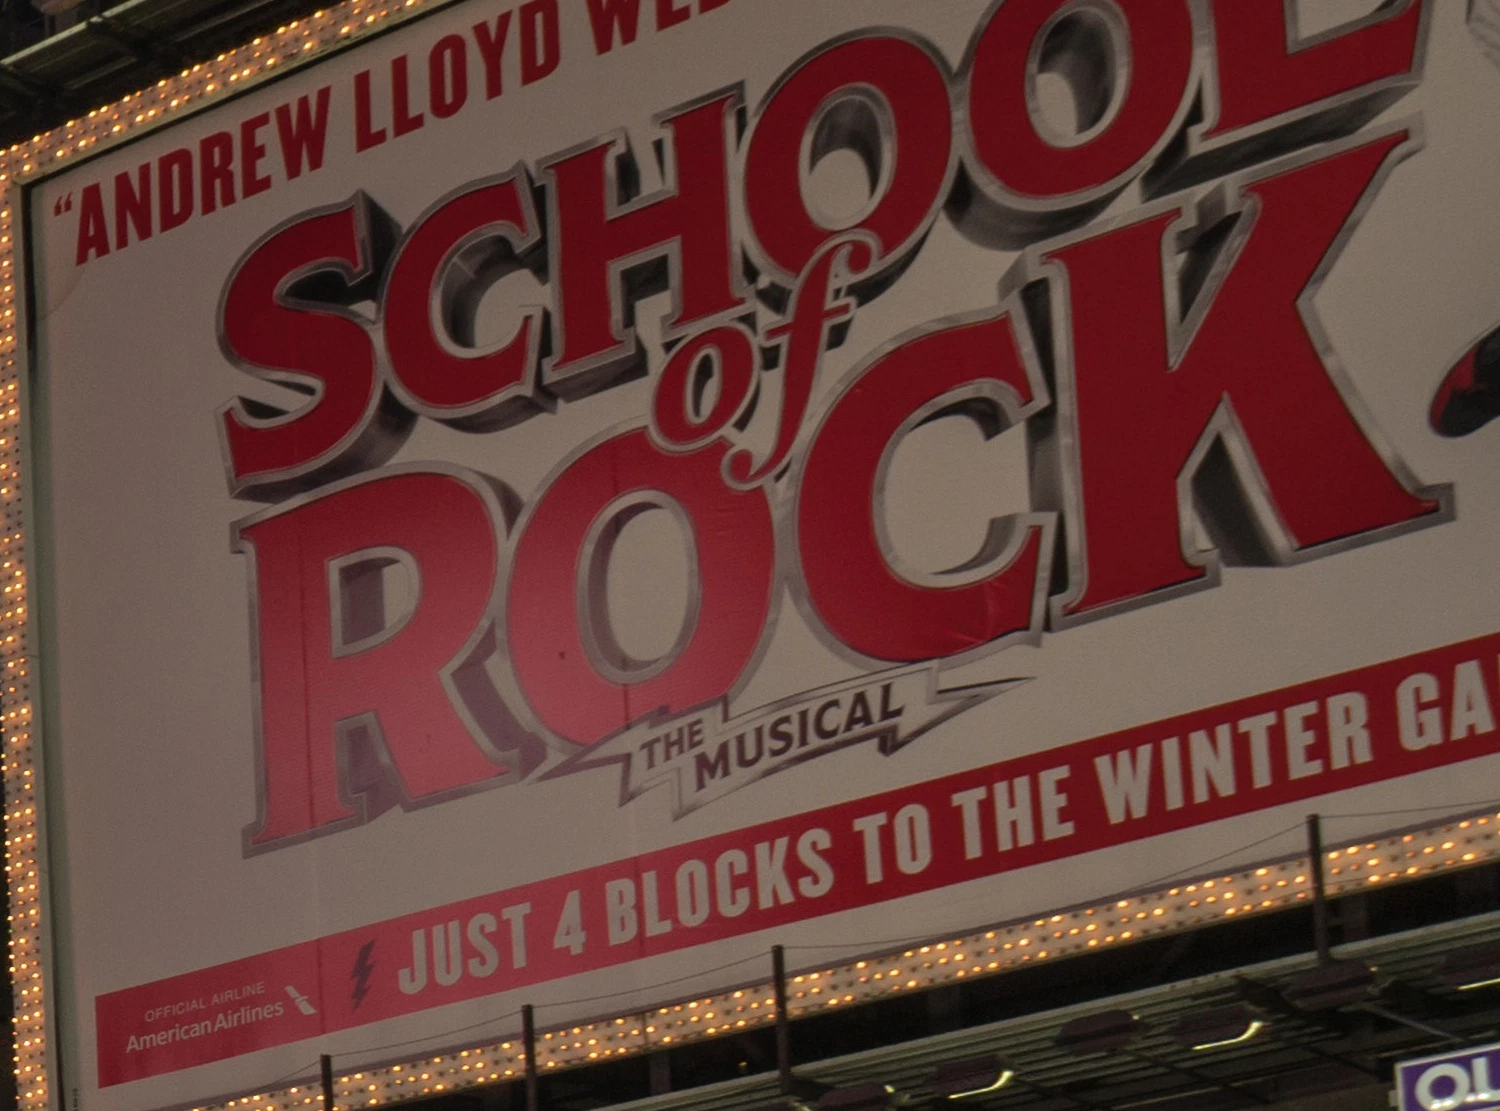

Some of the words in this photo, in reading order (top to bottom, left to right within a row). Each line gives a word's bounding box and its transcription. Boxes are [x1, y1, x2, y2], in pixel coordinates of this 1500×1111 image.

[52, 88, 333, 267] “ANDREW
[353, 0, 561, 153] LLOYD
[230, 112, 1456, 860] ROCK
[652, 230, 882, 490] of
[398, 905, 533, 995] JUST
[553, 890, 586, 957] 4
[607, 828, 833, 945] BLOCKS
[853, 803, 932, 883] TO
[952, 766, 1074, 860] THE
[1094, 692, 1372, 826] WINTER
[1396, 653, 1500, 751] GA
[638, 716, 704, 770] THE
[695, 684, 905, 794] MUSICAL
[127, 1018, 211, 1053] American
[215, 1002, 284, 1031] Airlines
[144, 999, 206, 1022] OFFICIAL
[211, 981, 266, 1005] AIRLINE
